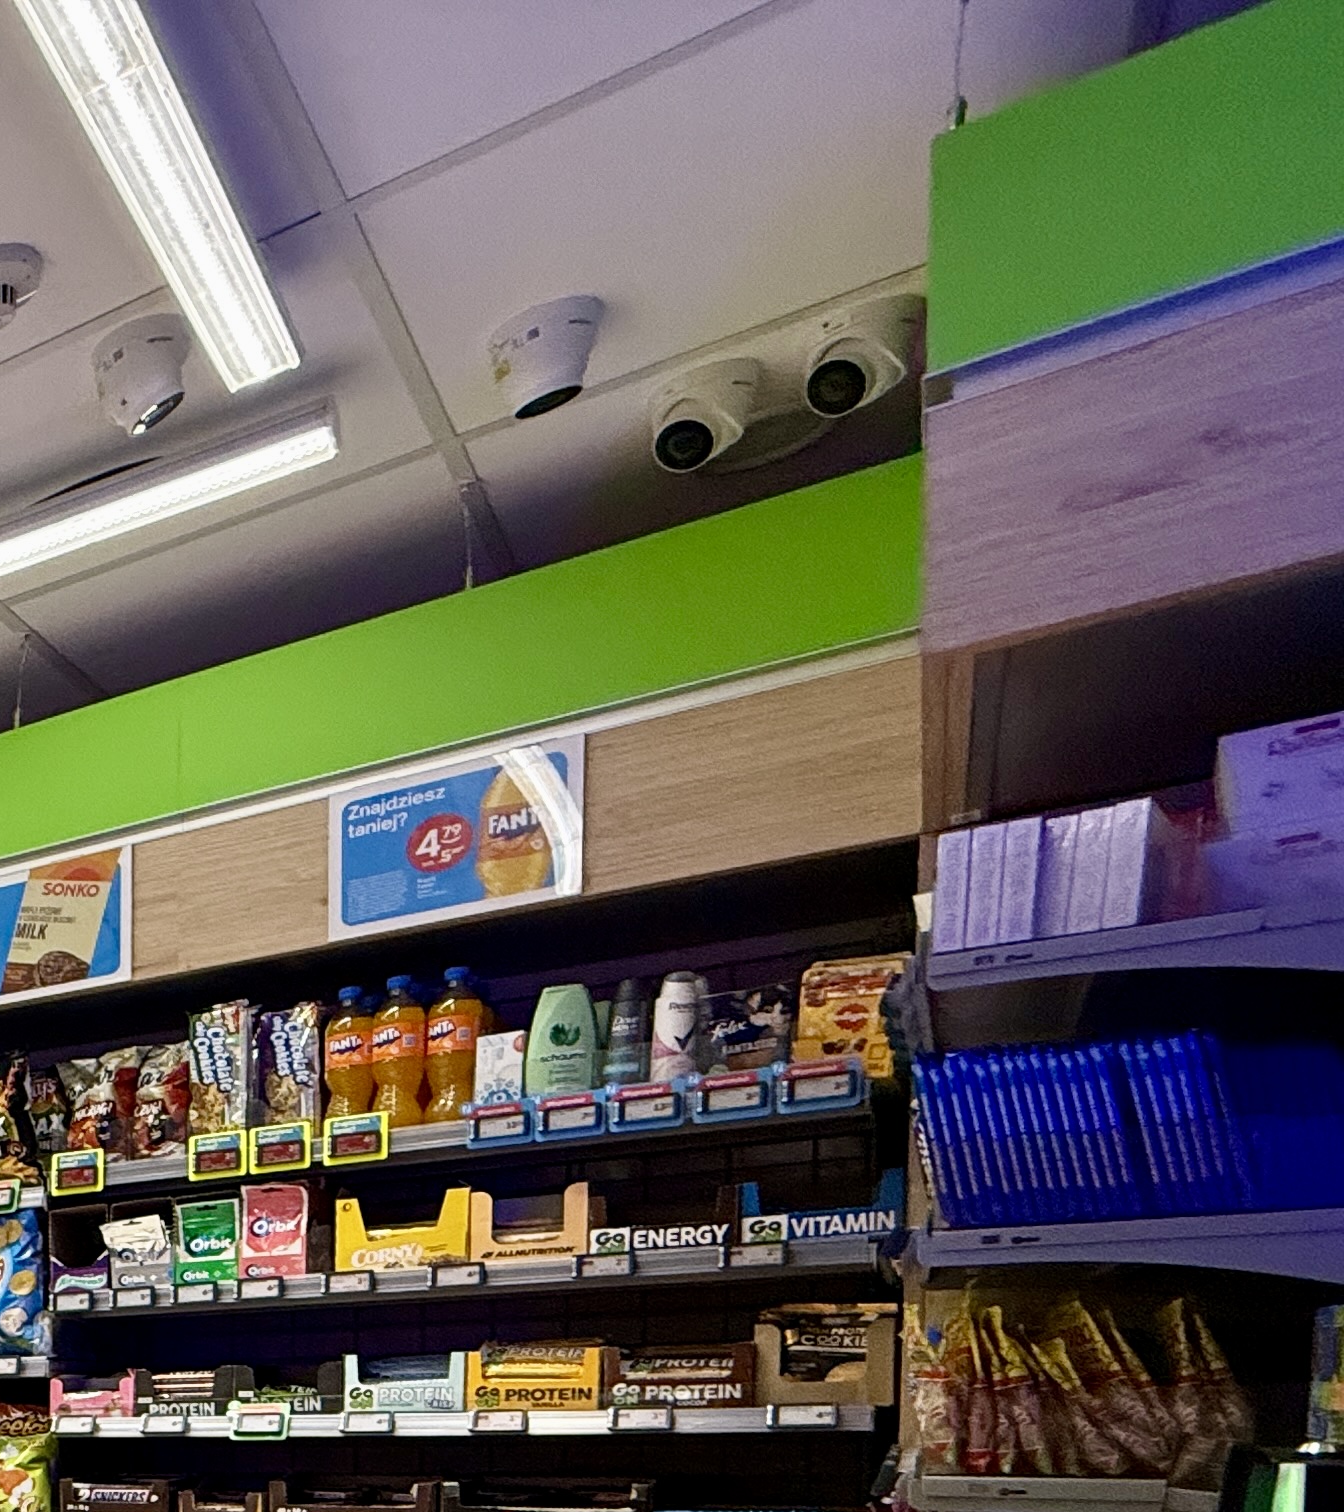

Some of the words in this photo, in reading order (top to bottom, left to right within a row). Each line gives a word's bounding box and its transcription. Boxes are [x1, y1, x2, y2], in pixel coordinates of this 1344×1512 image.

[348, 788, 446, 821] Znajdziesz
[348, 812, 408, 839] taniej?
[488, 806, 543, 835] FANT
[415, 828, 441, 857] 4
[41, 882, 100, 898] SONKO
[14, 922, 48, 940] MILK
[251, 1217, 298, 1236] Orbit
[791, 1211, 895, 1237] VITAMIN
[190, 1236, 233, 1252] Orbit
[633, 1224, 729, 1249] ENERGY
[351, 1244, 423, 1268] CORNY
[183, 1268, 210, 1280] Orbit
[378, 1387, 454, 1402] PROTEIN
[504, 1387, 593, 1402] PROTEIN
[645, 1383, 742, 1401] PROTEIN
[91, 1489, 148, 1503] SNICKERS
